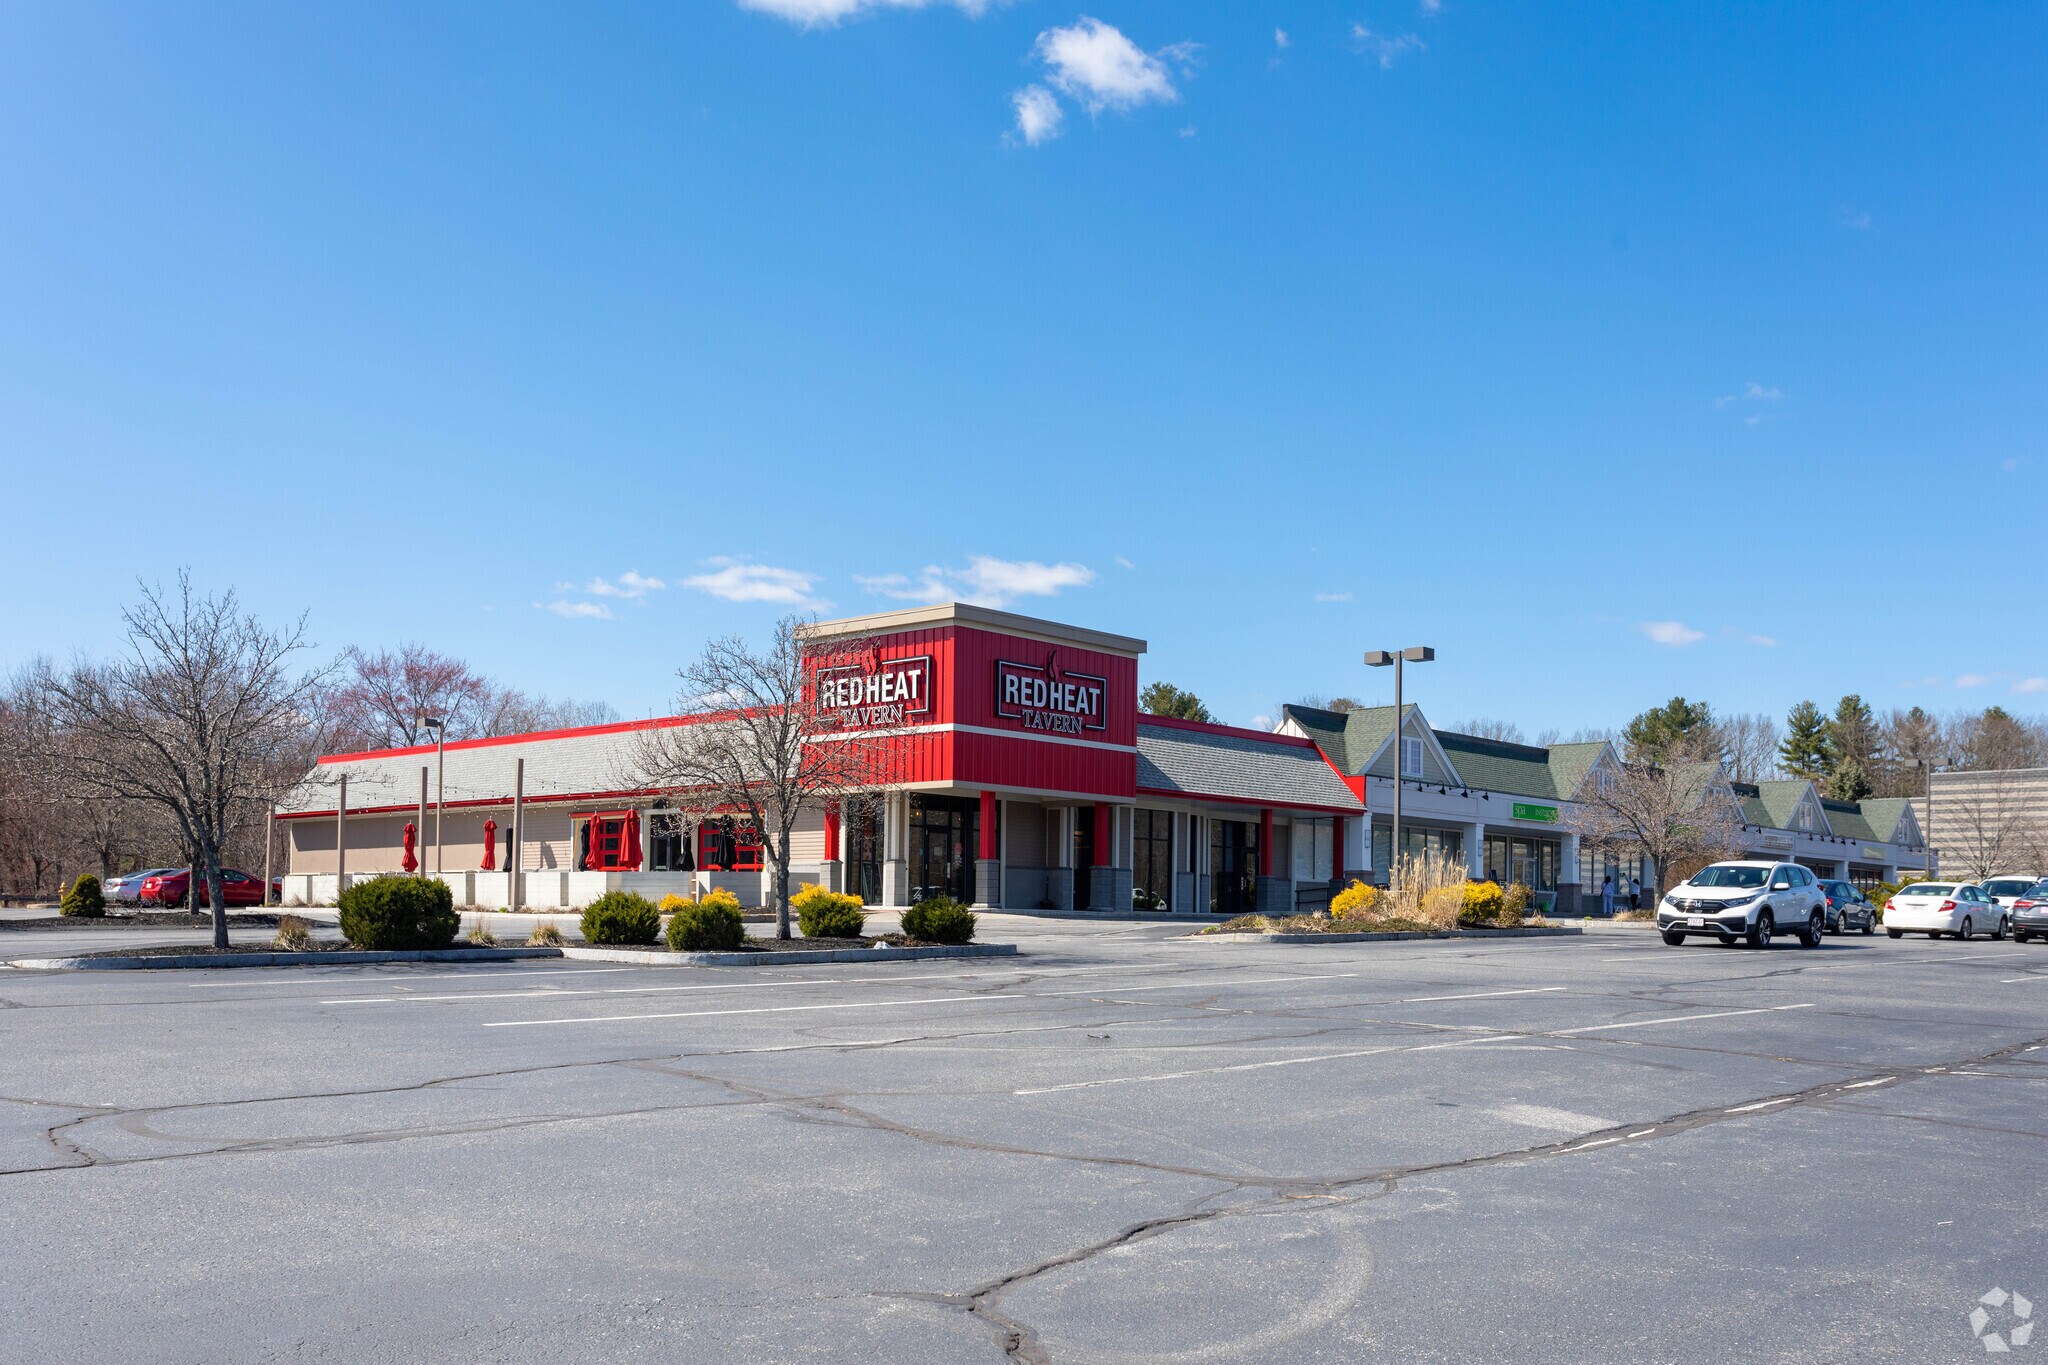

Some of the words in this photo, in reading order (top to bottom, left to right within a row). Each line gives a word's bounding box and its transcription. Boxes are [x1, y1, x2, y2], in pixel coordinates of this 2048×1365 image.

[823, 677, 863, 708] RED
[866, 669, 921, 704] HEAT
[1005, 674, 1047, 707] RED
[1050, 681, 1100, 715] HEAT
[841, 704, 903, 727] TAVERN
[1022, 709, 1084, 735] TAVERN
